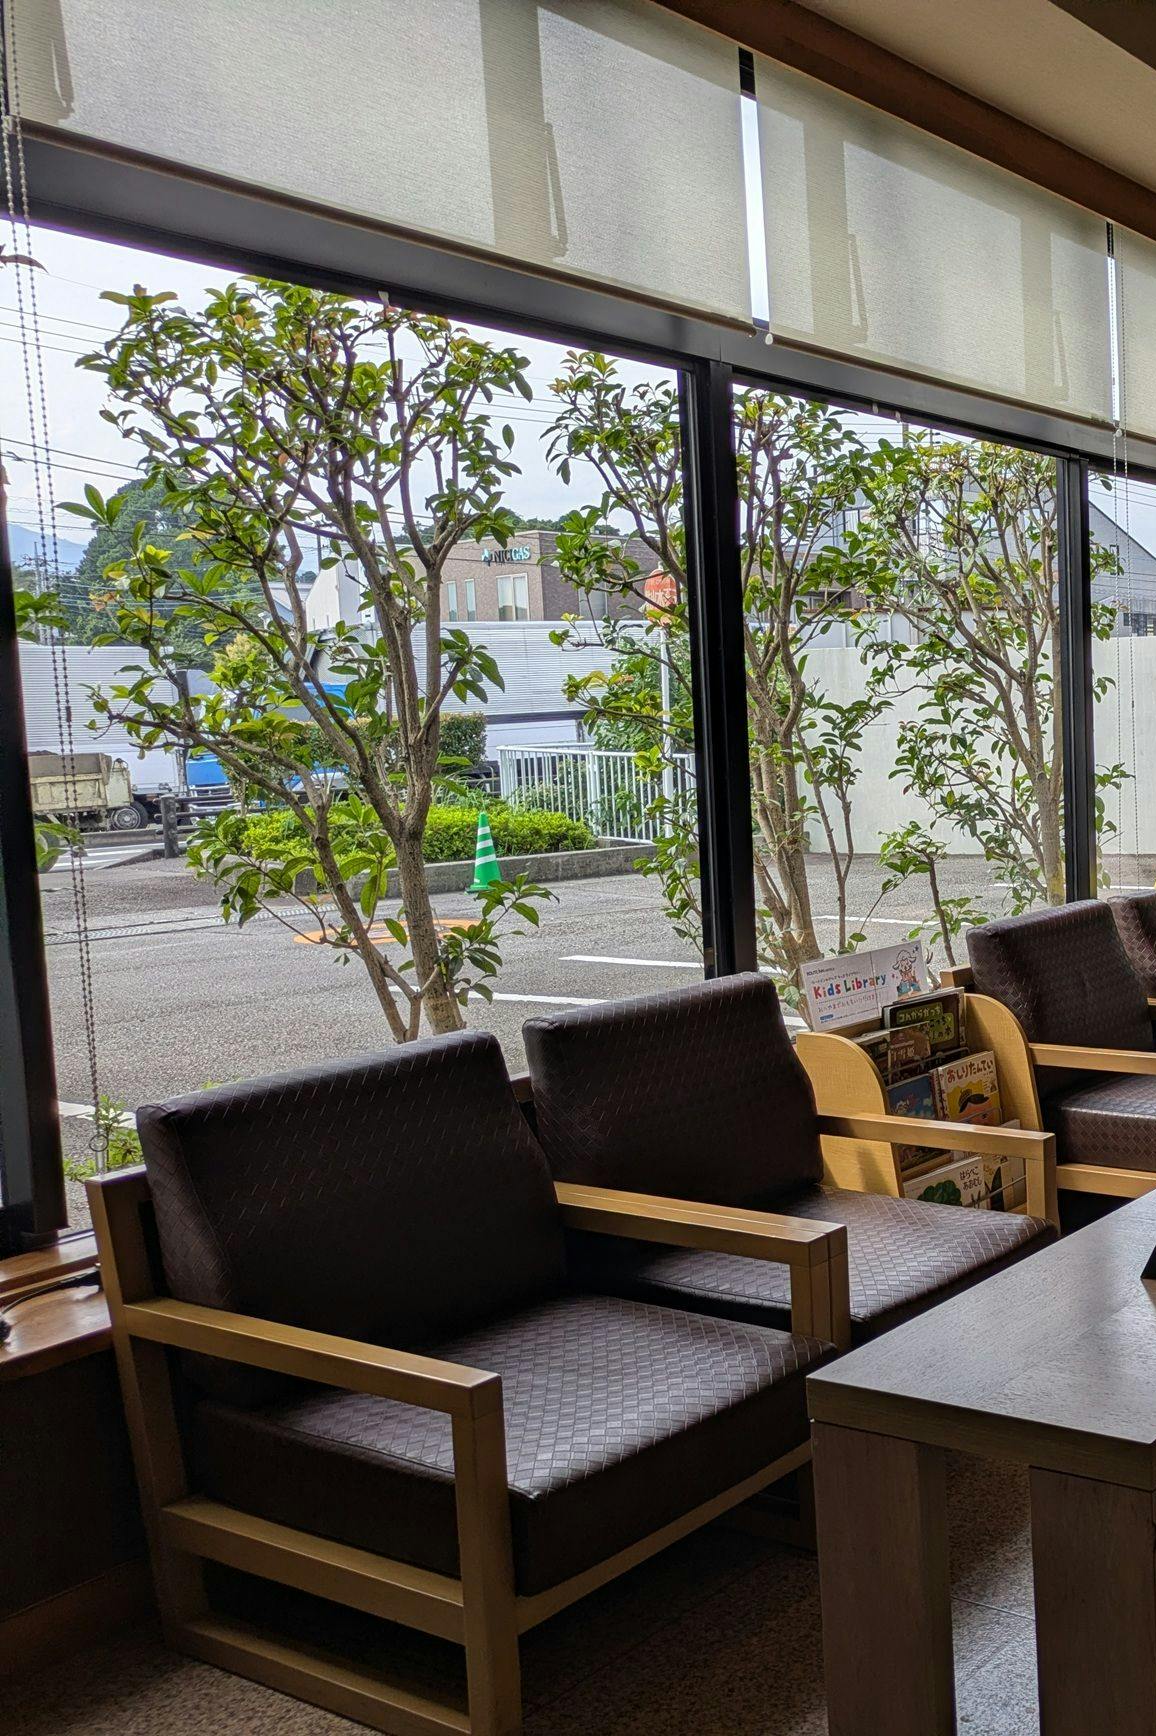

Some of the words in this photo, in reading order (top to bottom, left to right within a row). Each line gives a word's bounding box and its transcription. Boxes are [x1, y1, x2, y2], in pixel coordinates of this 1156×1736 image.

[813, 982, 841, 1000] Kids
[844, 974, 886, 993] Library
[946, 1059, 994, 1083] おしりたんてい
